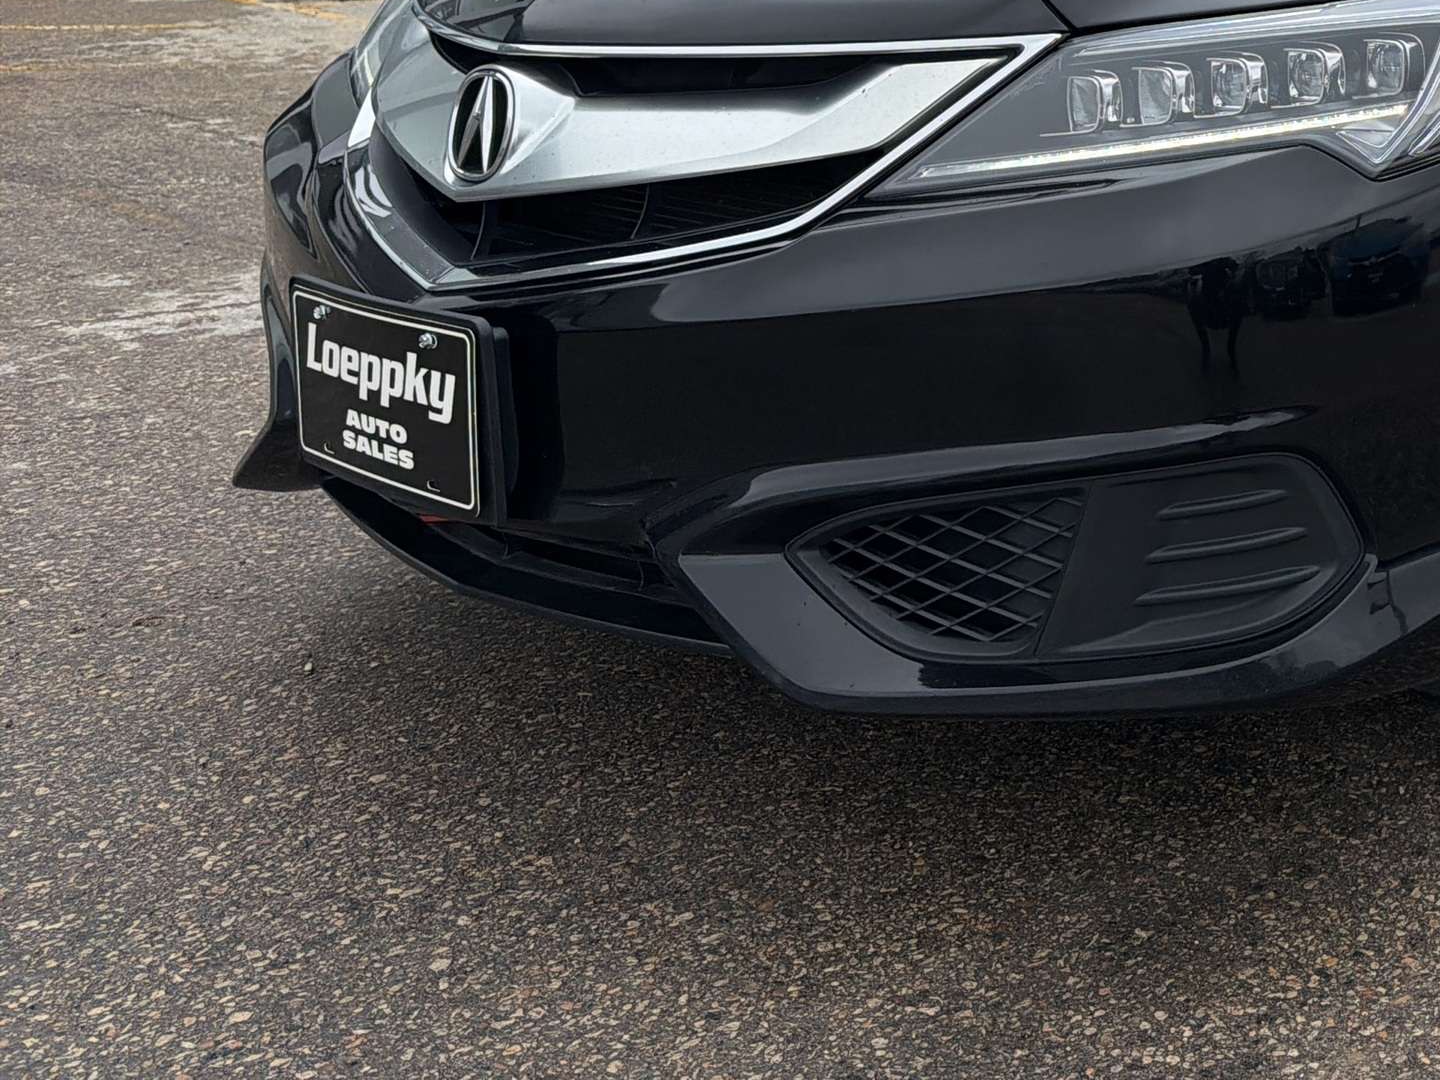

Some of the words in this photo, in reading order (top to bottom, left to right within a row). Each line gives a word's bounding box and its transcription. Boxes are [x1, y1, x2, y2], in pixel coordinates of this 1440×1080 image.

[306, 322, 456, 424] Loeppky
[346, 409, 408, 444] AUTO
[342, 430, 415, 470] SALES
